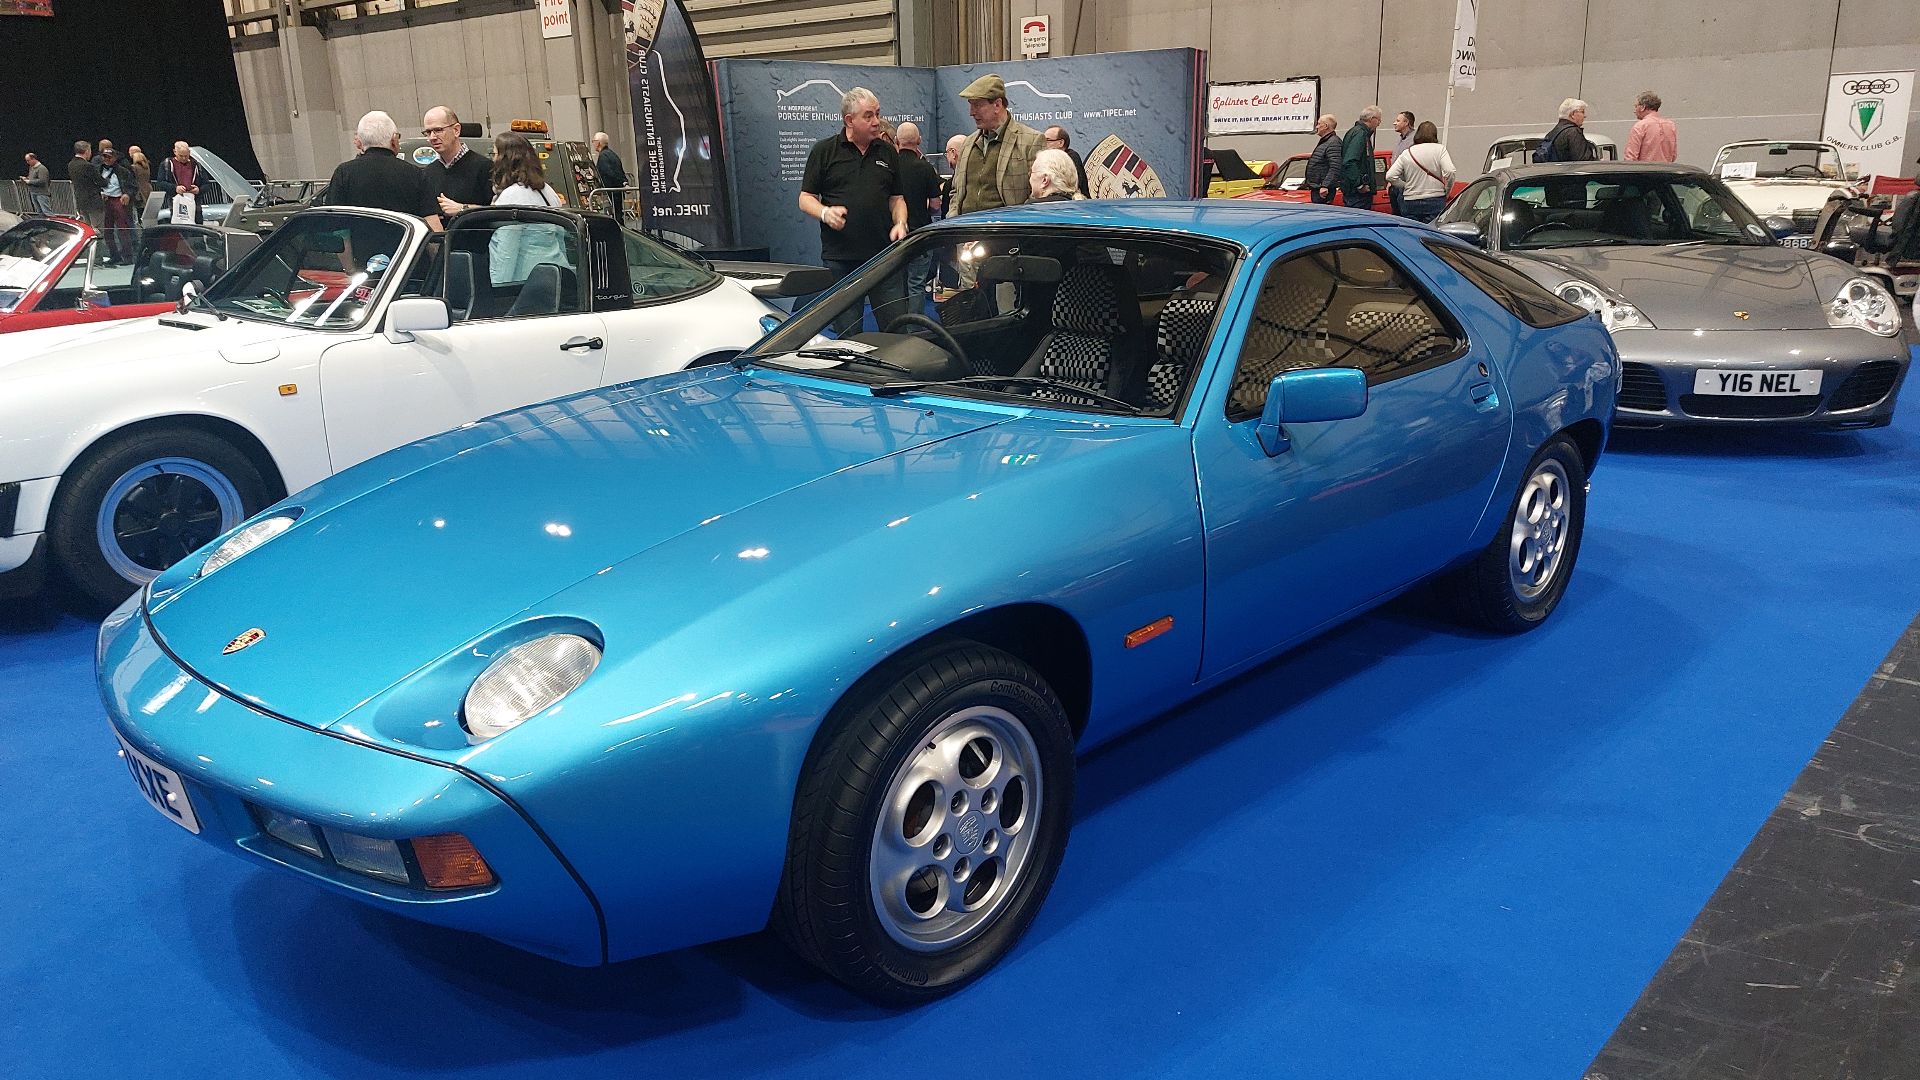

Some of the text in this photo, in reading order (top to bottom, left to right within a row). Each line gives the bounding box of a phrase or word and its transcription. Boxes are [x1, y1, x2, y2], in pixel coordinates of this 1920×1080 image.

[543, 11, 569, 30] point
[1213, 92, 1313, 111] Splinter Cell Car Club
[778, 112, 809, 121] PORSCHE
[1012, 110, 1073, 121] NTHUSIASTS CLUB
[1083, 108, 1137, 118] www.TIPEC.net
[1826, 135, 1859, 151] OWNERS
[1860, 143, 1883, 151] CLUB
[595, 293, 629, 301] targa
[1718, 373, 1801, 393] Y16 NEL
